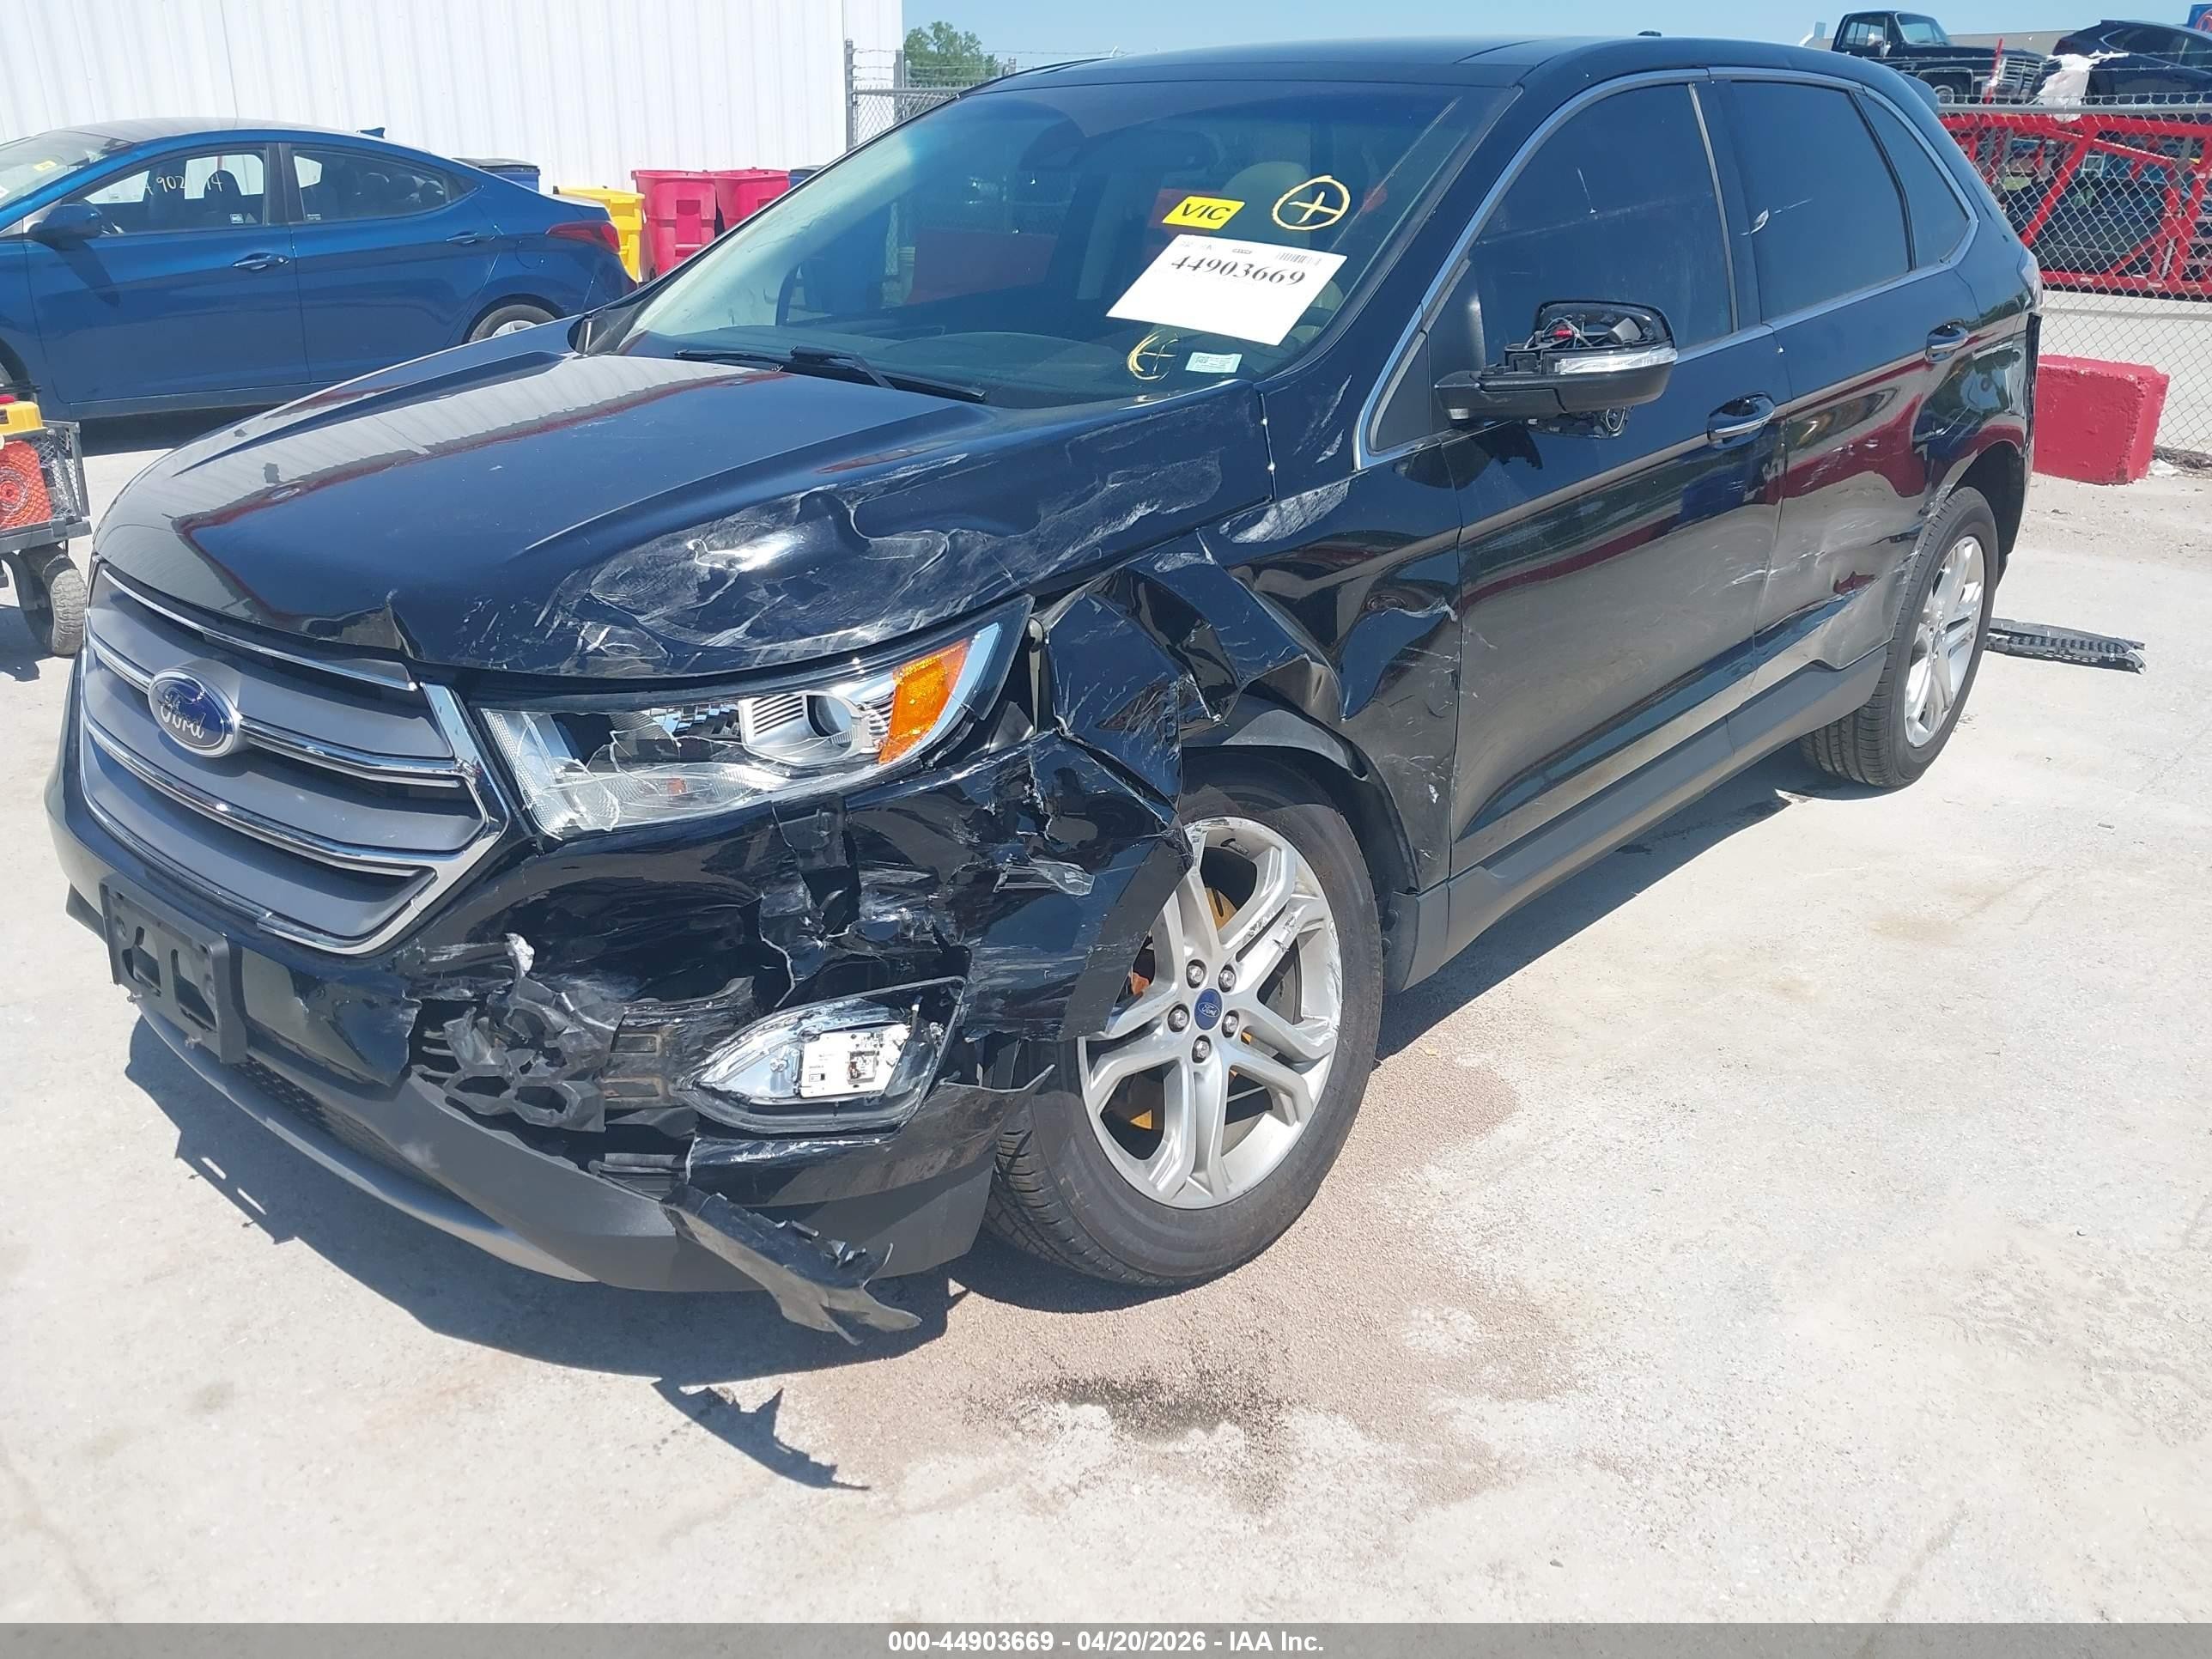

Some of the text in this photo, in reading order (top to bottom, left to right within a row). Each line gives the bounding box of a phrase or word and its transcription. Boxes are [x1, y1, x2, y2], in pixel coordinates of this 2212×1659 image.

[1182, 204, 1231, 220] VIC
[1171, 255, 1306, 285] 44903669
[1201, 1004, 1218, 1016] Ford
